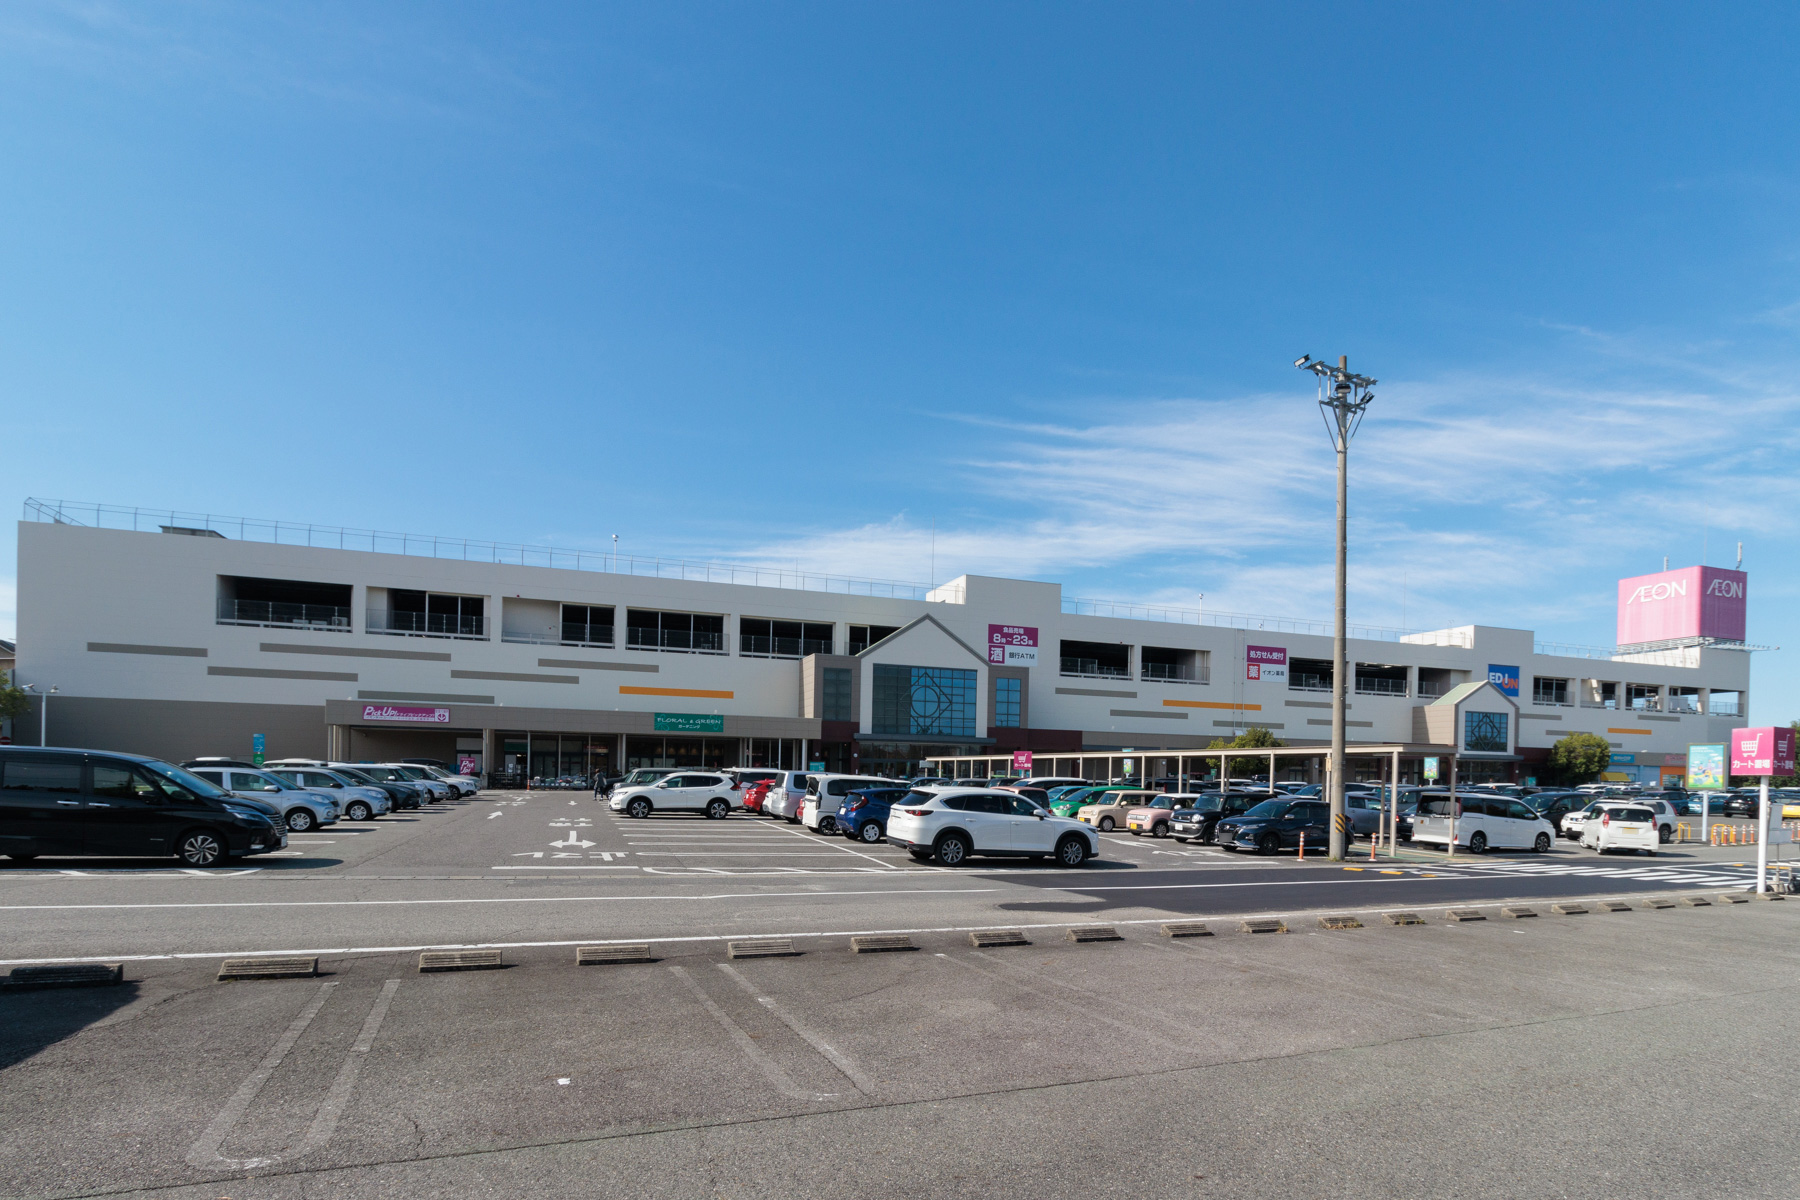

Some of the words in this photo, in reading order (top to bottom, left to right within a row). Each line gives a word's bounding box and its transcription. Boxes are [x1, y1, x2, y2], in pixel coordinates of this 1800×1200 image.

[990, 647, 1003, 661] 酒
[1250, 650, 1284, 661] 処方せん受付
[1248, 665, 1259, 678] 薬
[1489, 672, 1519, 689] EDION
[1732, 759, 1771, 769] カート置場
